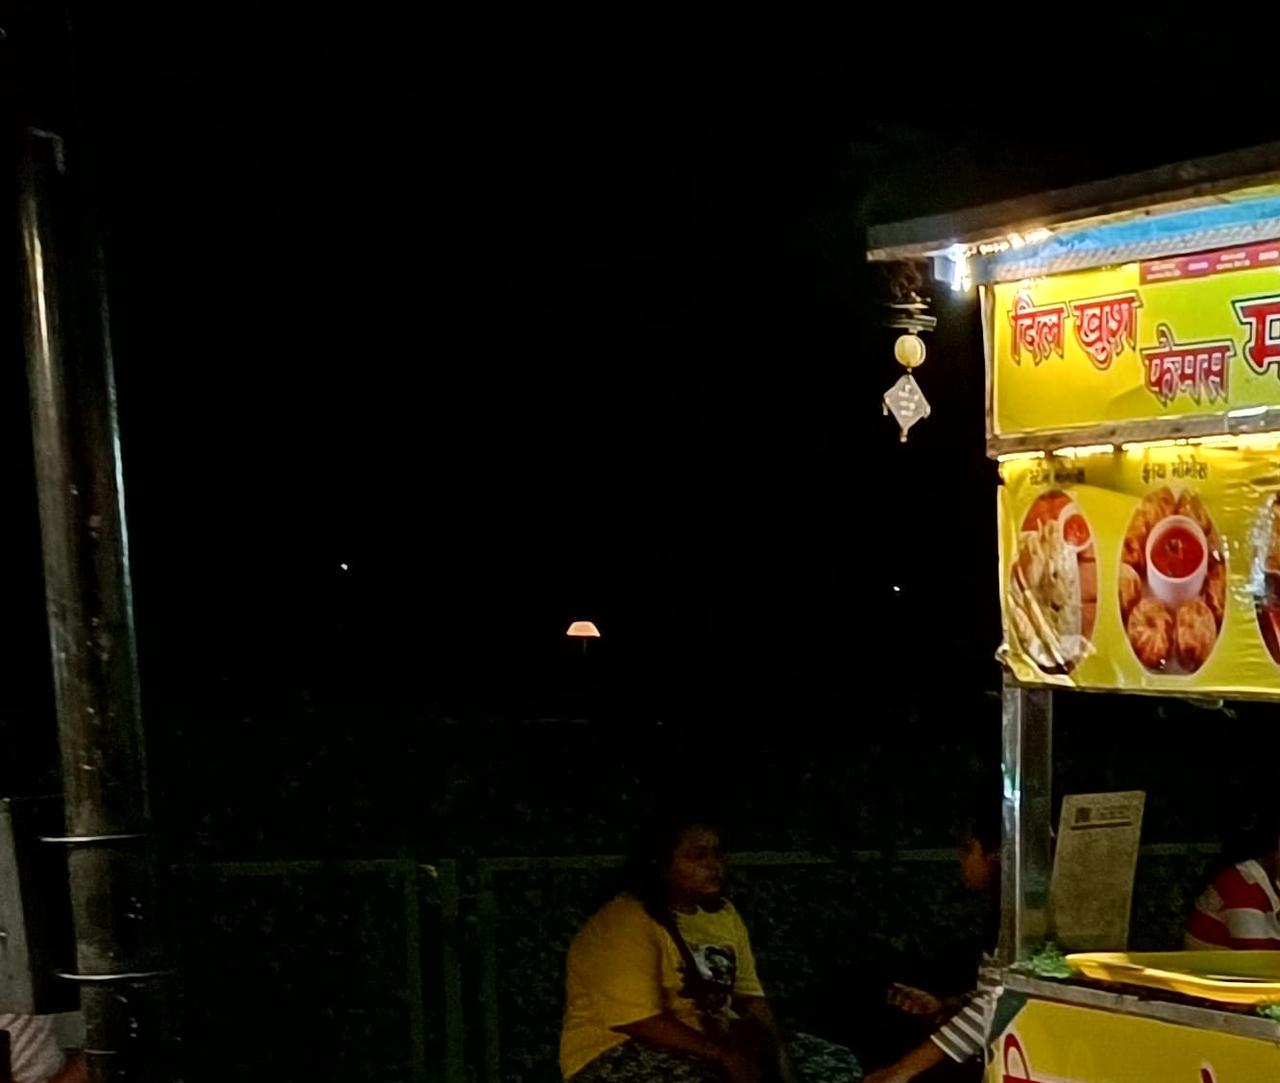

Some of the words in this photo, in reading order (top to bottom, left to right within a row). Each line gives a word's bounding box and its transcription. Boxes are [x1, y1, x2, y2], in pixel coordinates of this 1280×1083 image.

[1009, 289, 1066, 365] दिल
[1070, 291, 1142, 369] खुश
[1140, 324, 1234, 408] फेमस
